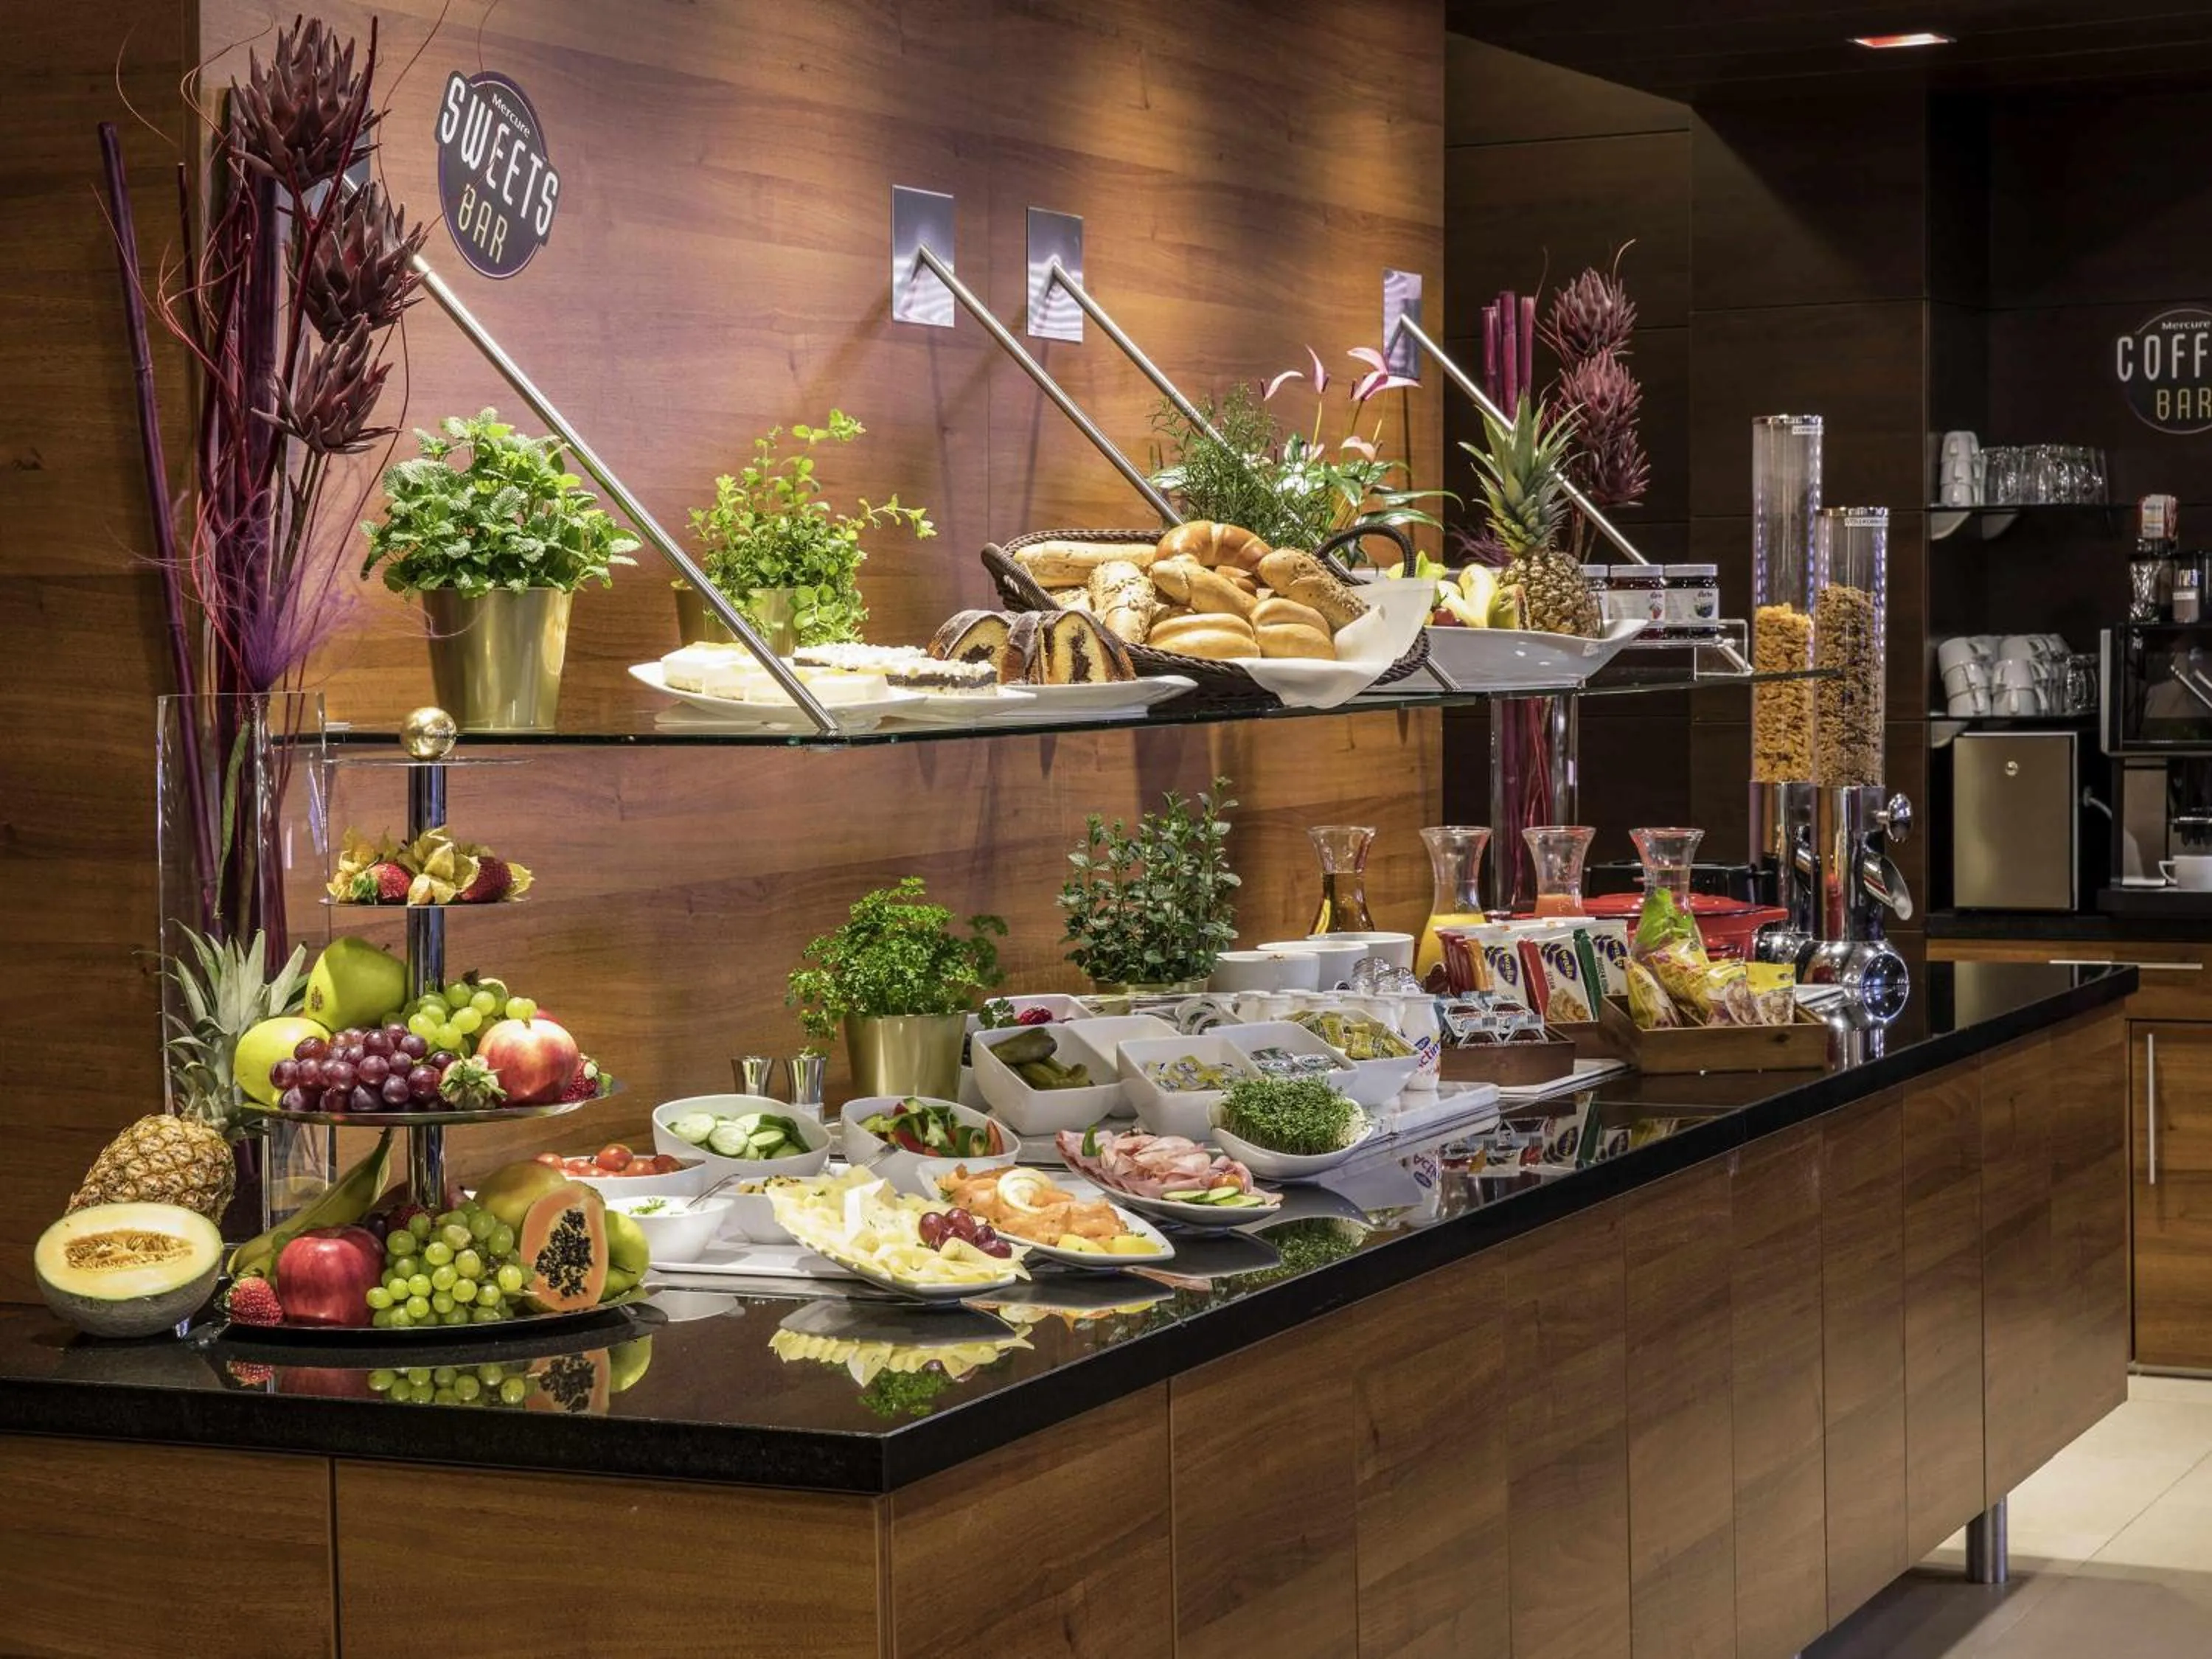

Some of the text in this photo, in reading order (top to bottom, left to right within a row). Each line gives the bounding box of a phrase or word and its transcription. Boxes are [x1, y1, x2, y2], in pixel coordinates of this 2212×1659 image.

[492, 94, 530, 138] Mercure
[442, 77, 558, 237] SWEETS
[458, 184, 508, 264] BAR
[2161, 321, 2211, 330] Mercure
[2156, 387, 2212, 421] BAR
